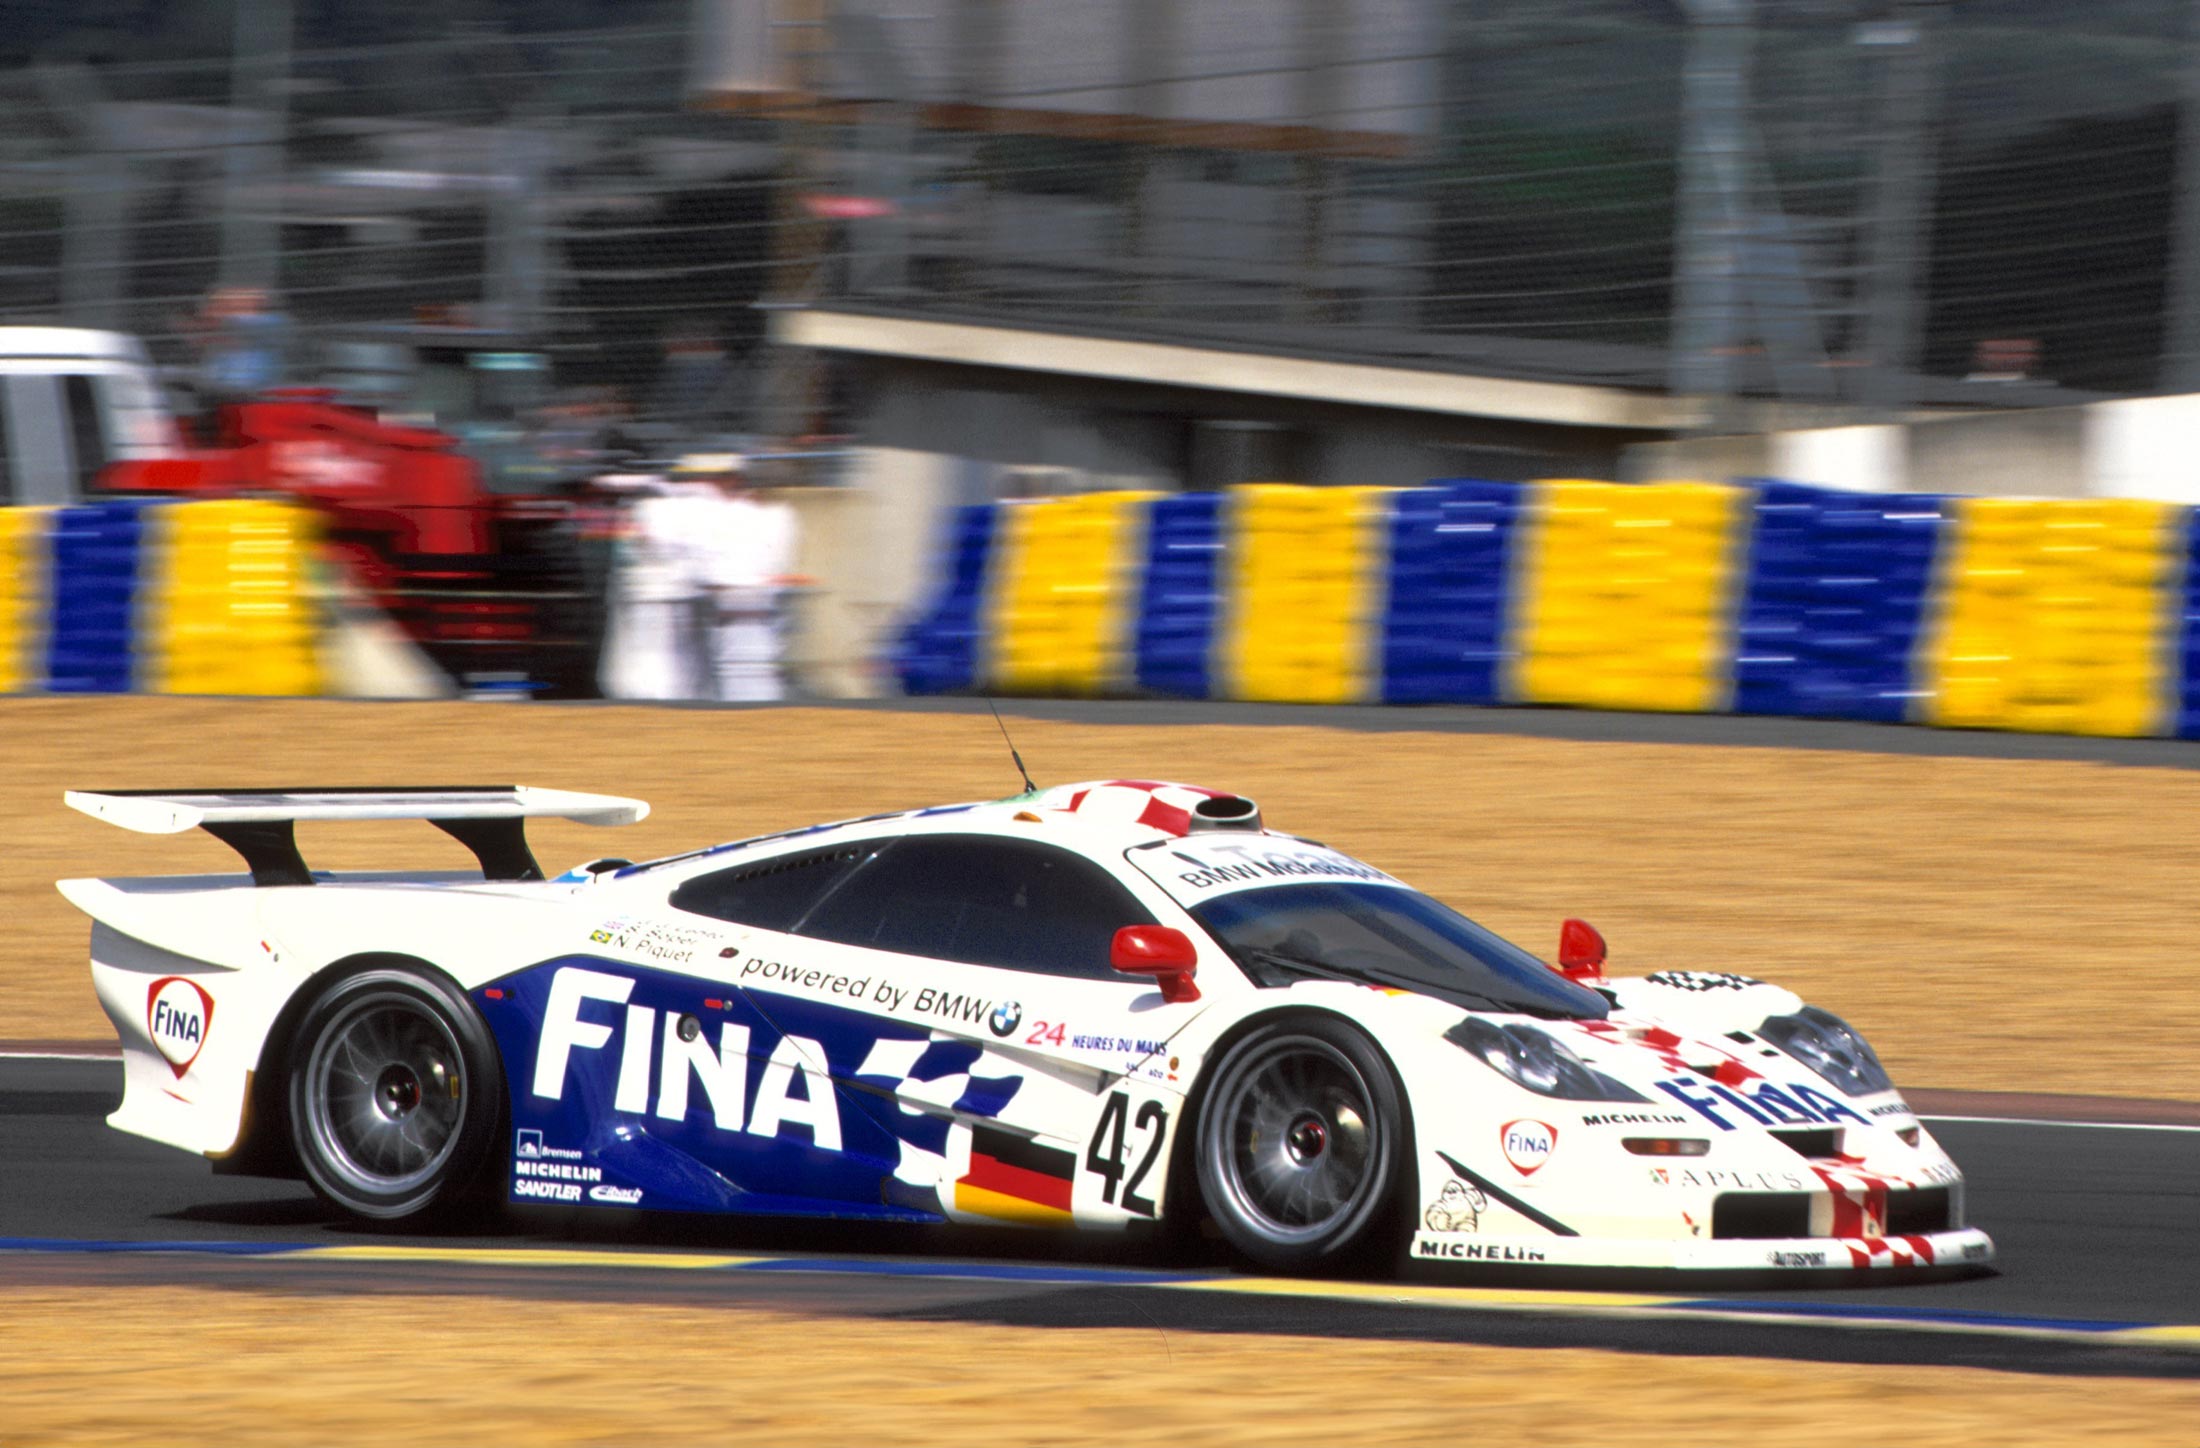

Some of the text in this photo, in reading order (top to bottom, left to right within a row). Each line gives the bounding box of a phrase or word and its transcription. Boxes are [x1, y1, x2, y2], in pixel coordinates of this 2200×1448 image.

[1179, 864, 1261, 888] BMW
[635, 939, 693, 962] Piquet
[741, 957, 991, 1024] powered by BMW
[154, 1000, 200, 1044] FINA
[1025, 1020, 1167, 1057] 24 HEURES DU MANS
[533, 966, 842, 1151] FINA
[1653, 1077, 1874, 1131] FINA
[1582, 1114, 1687, 1126] MICHELIN
[542, 1146, 582, 1160] Bremsen
[1086, 1090, 1169, 1218] 42
[1508, 1133, 1548, 1153] FINA
[516, 1161, 601, 1181] MICHELIN
[1681, 1169, 1803, 1191] APLUS
[1420, 1241, 1545, 1262] MICHELIN
